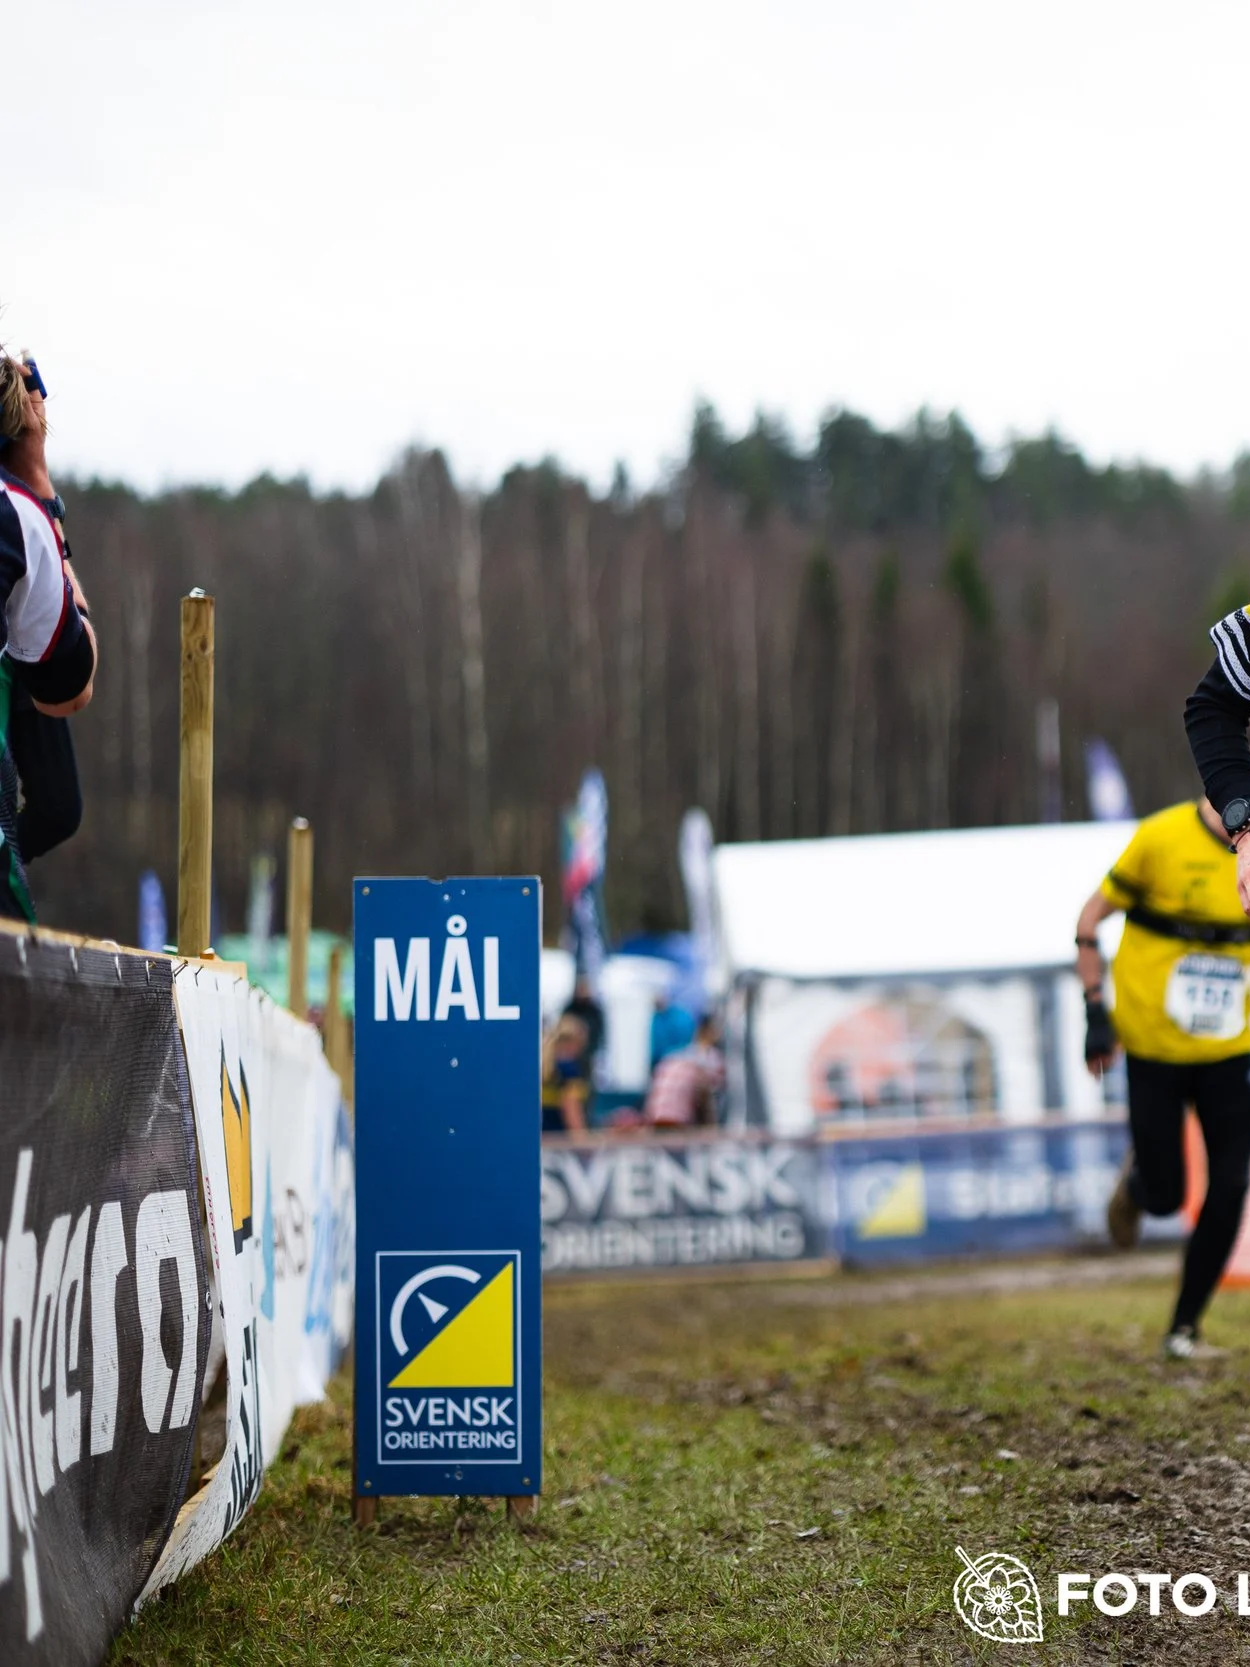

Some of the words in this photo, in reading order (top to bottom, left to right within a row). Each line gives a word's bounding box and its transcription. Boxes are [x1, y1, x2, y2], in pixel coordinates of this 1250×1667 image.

[374, 914, 521, 1022] MÅL
[385, 1396, 516, 1427] SVENSK
[384, 1430, 517, 1450] ORIENTERING
